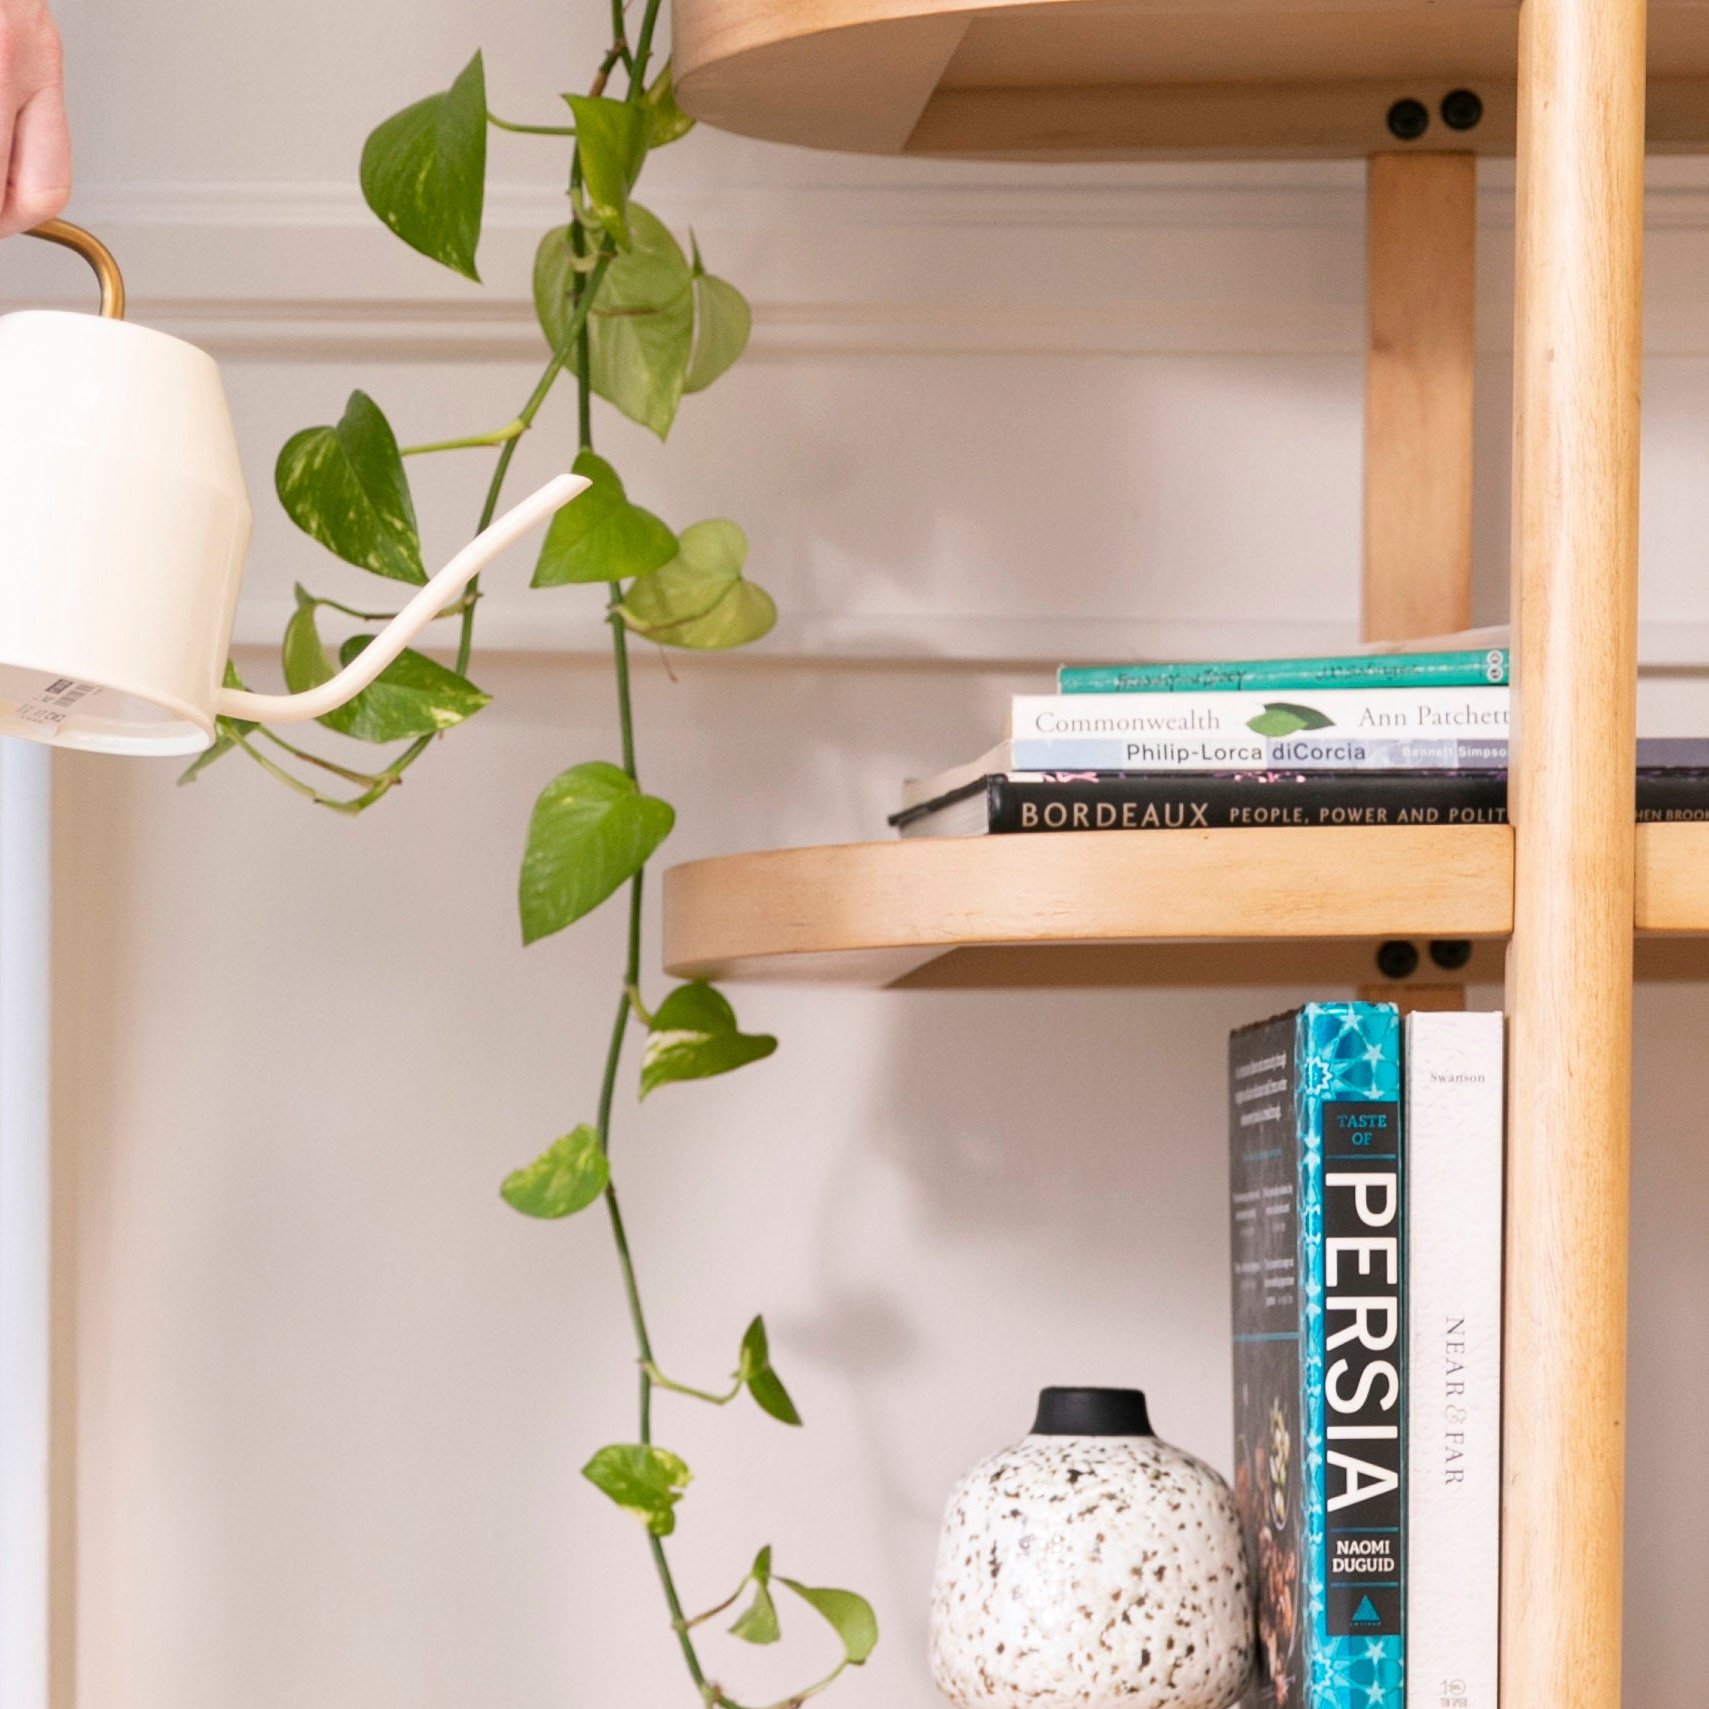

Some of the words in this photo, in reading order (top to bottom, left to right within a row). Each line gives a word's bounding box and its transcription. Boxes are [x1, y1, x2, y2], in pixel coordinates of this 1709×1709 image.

[1035, 709, 1221, 733] Commonwealth
[1359, 706, 1407, 728] Ann
[1418, 703, 1509, 727] Patchett
[1126, 743, 1263, 764] Philip-Lorca
[1272, 742, 1366, 761] diCorcia
[1458, 745, 1508, 759] Simpso
[1021, 802, 1209, 828] BORDEAUX
[1228, 807, 1310, 824] PEOPLE,
[1319, 807, 1388, 823] POWER
[1397, 807, 1440, 823] AND
[1449, 807, 1507, 823] POLIT
[1635, 809, 1662, 821] HEN
[1430, 1072, 1486, 1084] Swanson
[1337, 1113, 1388, 1129] TASTE
[1351, 1132, 1373, 1146] OF
[1325, 1172, 1399, 1513] PERSIA
[1445, 1316, 1466, 1397] NEAR
[1445, 1404, 1468, 1425] &
[1445, 1432, 1465, 1486] FAR
[1336, 1540, 1390, 1555] NAOMI
[1332, 1557, 1395, 1573] DUGUID
